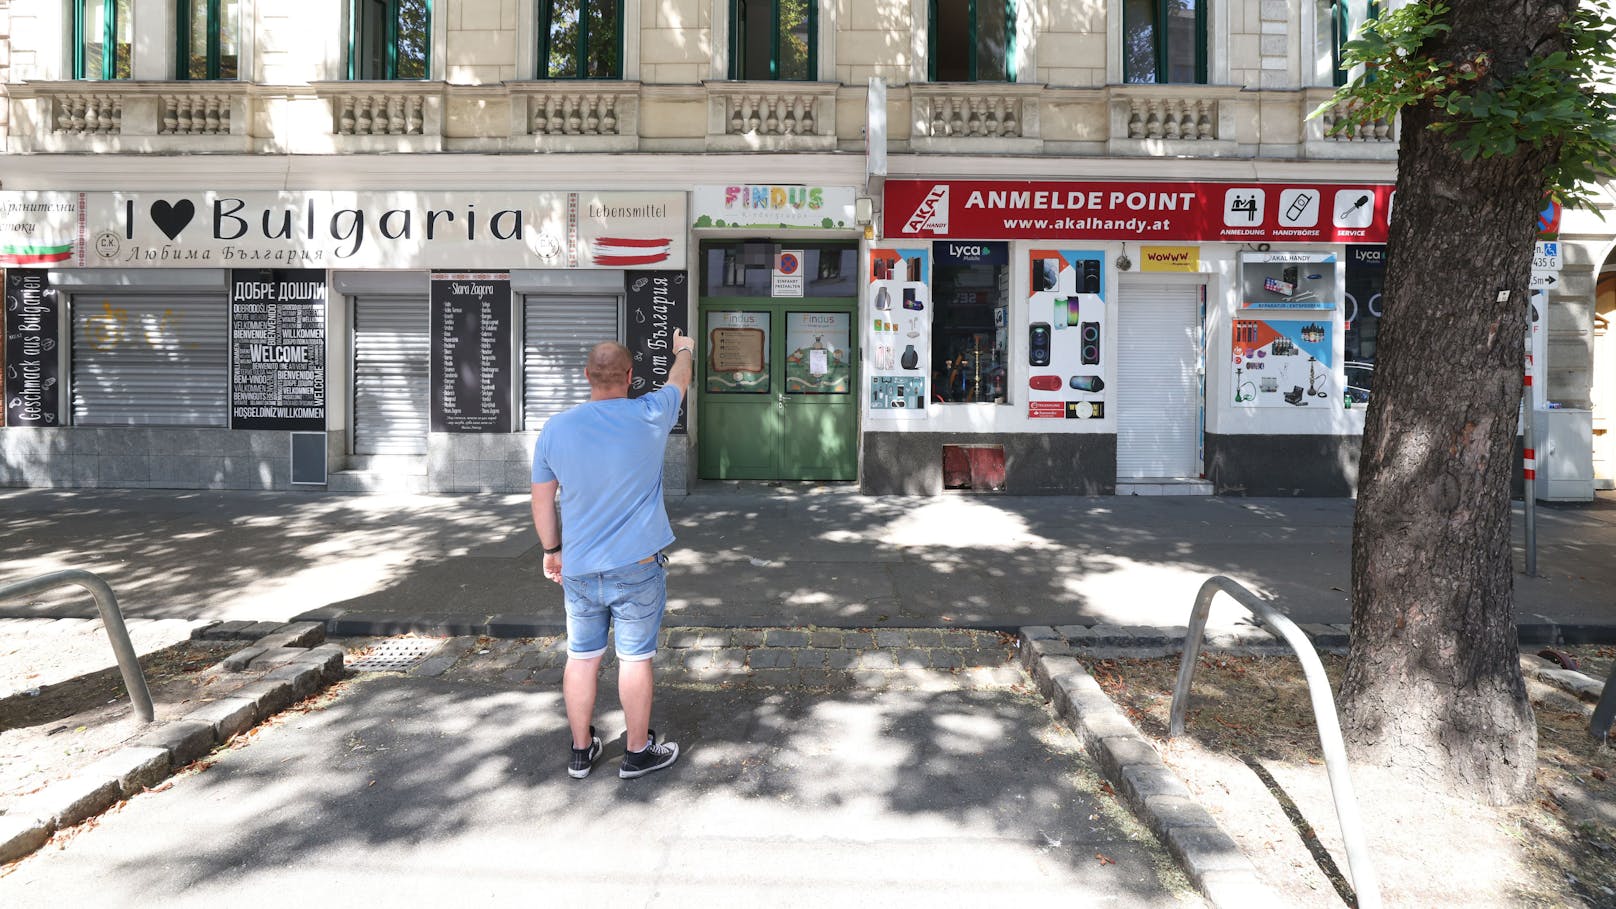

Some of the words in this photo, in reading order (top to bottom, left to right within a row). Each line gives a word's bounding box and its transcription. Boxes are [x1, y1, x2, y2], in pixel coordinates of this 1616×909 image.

[724, 186, 824, 210] FINDUS
[964, 190, 1103, 210] ANMELDE
[1109, 191, 1196, 211] POINT
[589, 203, 667, 219] Lebensmittel
[909, 190, 946, 231] AKAL
[126, 200, 134, 240] I
[213, 198, 523, 259] Bulgaria
[1003, 217, 1170, 233] www.akalhandy.at
[125, 244, 211, 262] Любима
[222, 246, 323, 264] България
[949, 244, 981, 258] Lyca
[1355, 249, 1381, 261] Lyca
[1550, 257, 1556, 267] G
[234, 282, 276, 301] ДОБРЕ
[278, 282, 325, 301] ДОШЛИ
[18, 276, 51, 332] Bulgarien
[647, 277, 676, 350] България
[723, 313, 755, 323] Findus
[803, 313, 834, 323] Findus
[267, 304, 276, 345] BIENVENIDO
[282, 329, 324, 338] WILLKOMMEN
[234, 330, 267, 338] BIENVENUE
[23, 335, 41, 356] aus
[250, 344, 308, 362] WELCOME
[652, 355, 667, 375] от
[234, 375, 266, 383] BEM-VINDO
[277, 370, 314, 379] BIENVENIDO
[18, 360, 42, 421] Geschmack
[314, 366, 324, 406] WELCOME
[277, 408, 324, 418] WILLKOMMEN
